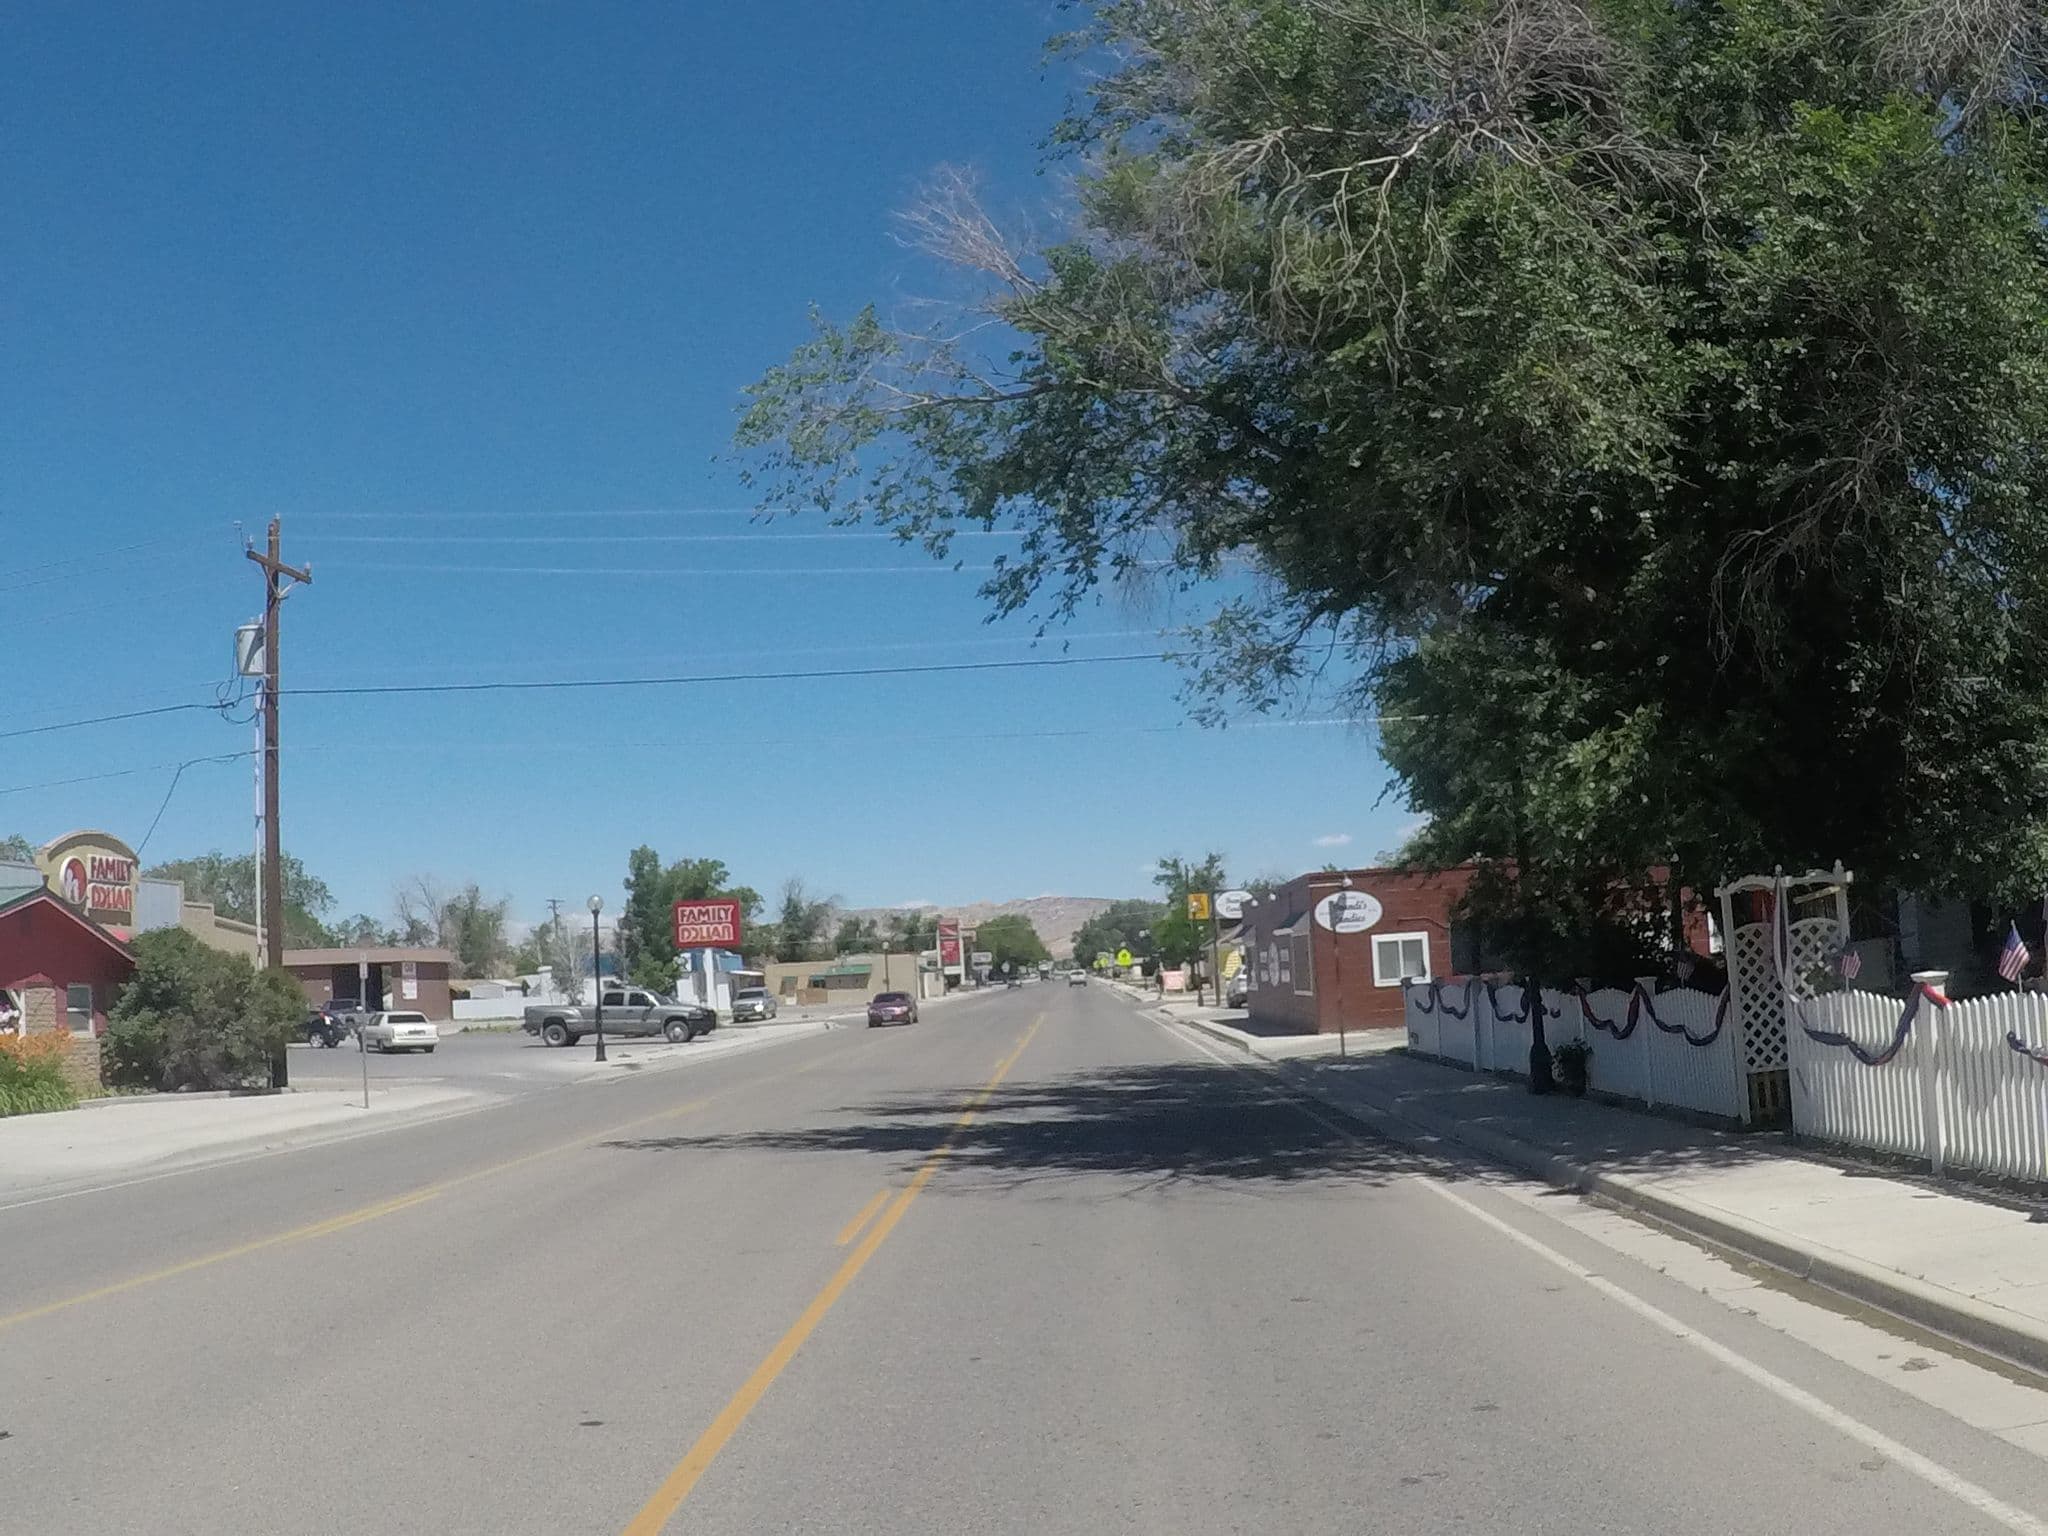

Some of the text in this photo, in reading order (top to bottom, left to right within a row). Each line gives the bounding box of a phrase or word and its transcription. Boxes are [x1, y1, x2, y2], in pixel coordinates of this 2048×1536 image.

[89, 855, 132, 882] FAMILY
[89, 884, 132, 911] DOLLAR
[678, 905, 734, 924] FAMILY
[679, 924, 733, 942] DOLLAR
